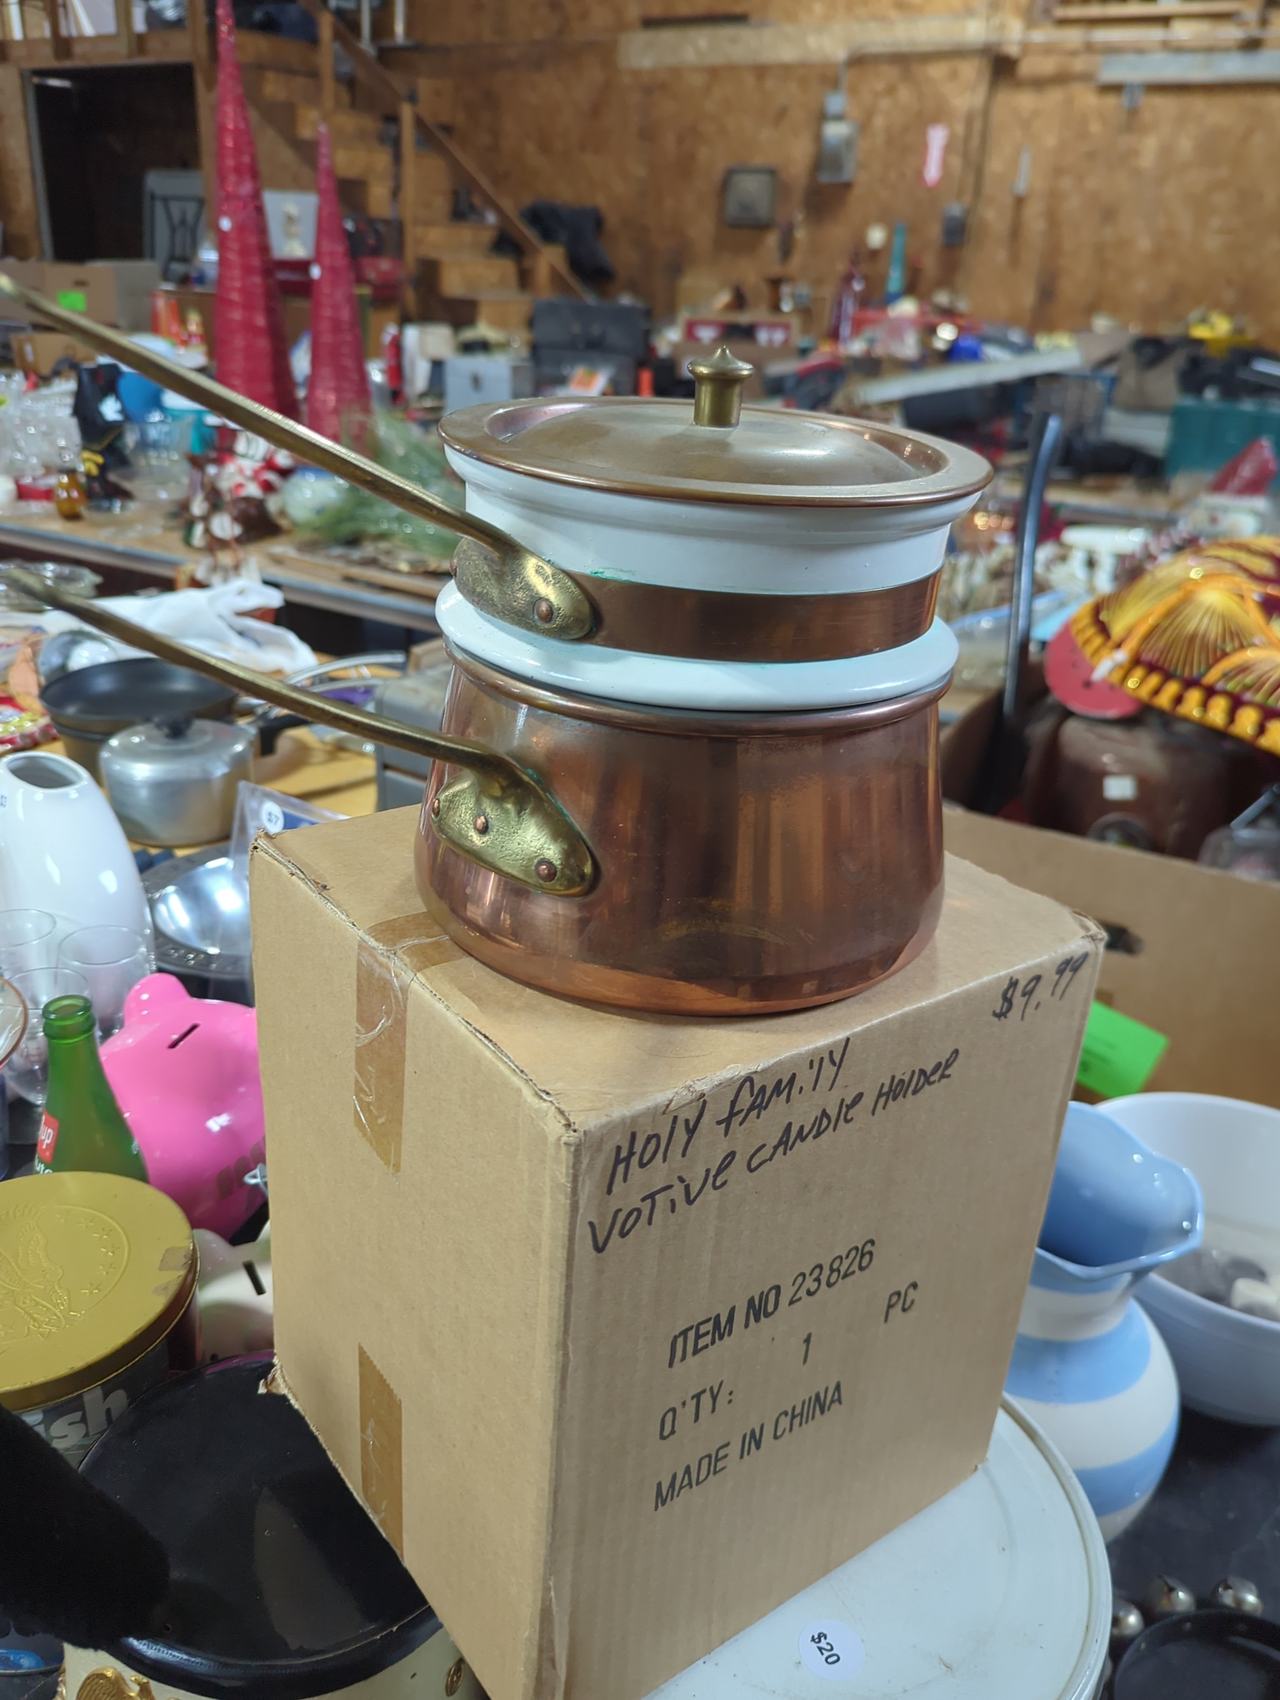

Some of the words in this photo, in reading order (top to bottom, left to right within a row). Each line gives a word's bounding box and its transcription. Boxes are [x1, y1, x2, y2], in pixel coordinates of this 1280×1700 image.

[992, 951, 1090, 1021] $9.99
[658, 1379, 734, 1441] Q'TY:
[802, 1332, 813, 1366] 1
[883, 1281, 919, 1324] PC
[667, 1304, 737, 1369] ITEM
[743, 1284, 782, 1330] NO
[788, 1238, 876, 1307] 23826
[654, 1441, 731, 1512] MADE
[738, 1422, 765, 1460] IN
[772, 1380, 843, 1441] CHINA
[810, 1631, 841, 1665] $20
